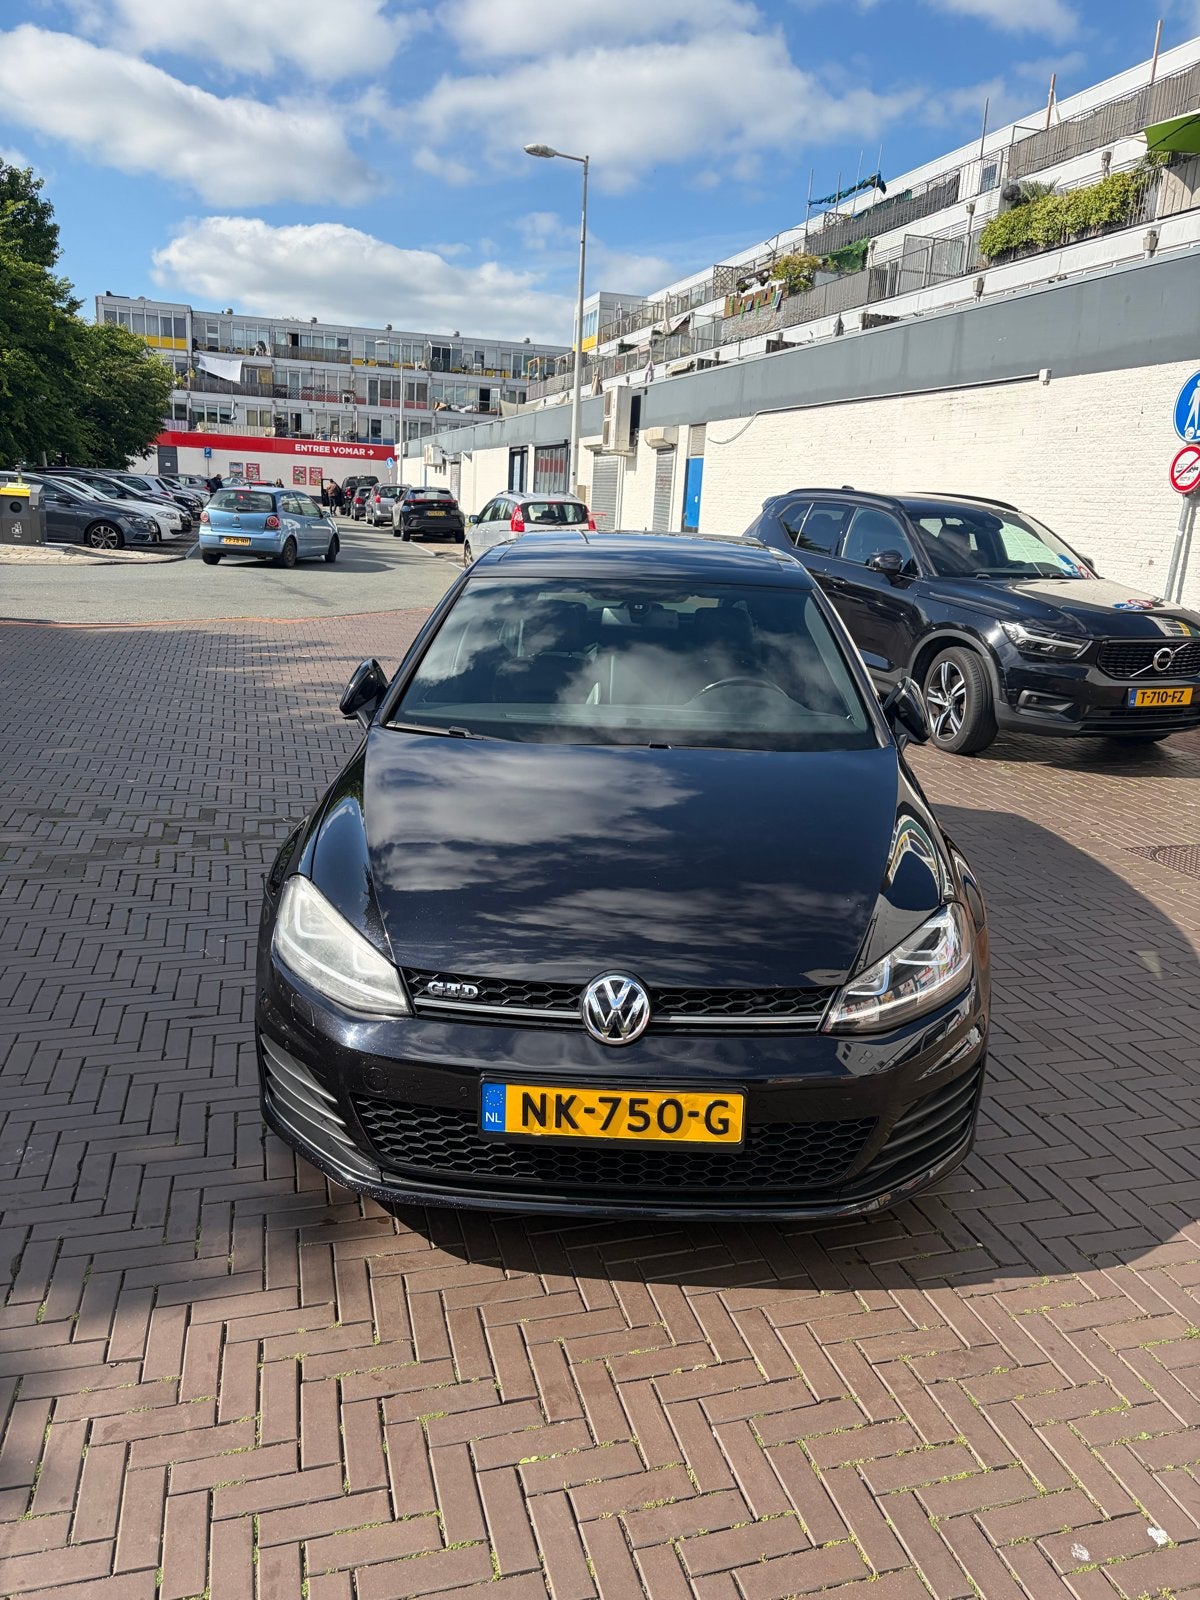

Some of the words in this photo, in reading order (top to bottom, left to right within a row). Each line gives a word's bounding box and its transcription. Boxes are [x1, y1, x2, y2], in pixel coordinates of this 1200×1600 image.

[294, 443, 331, 454] ENTREE
[332, 446, 366, 456] VOMAR
[1140, 690, 1185, 704] T-710-FZ
[427, 981, 479, 999] GTD
[485, 1111, 502, 1124] NL
[521, 1091, 730, 1135] NK-750-G
